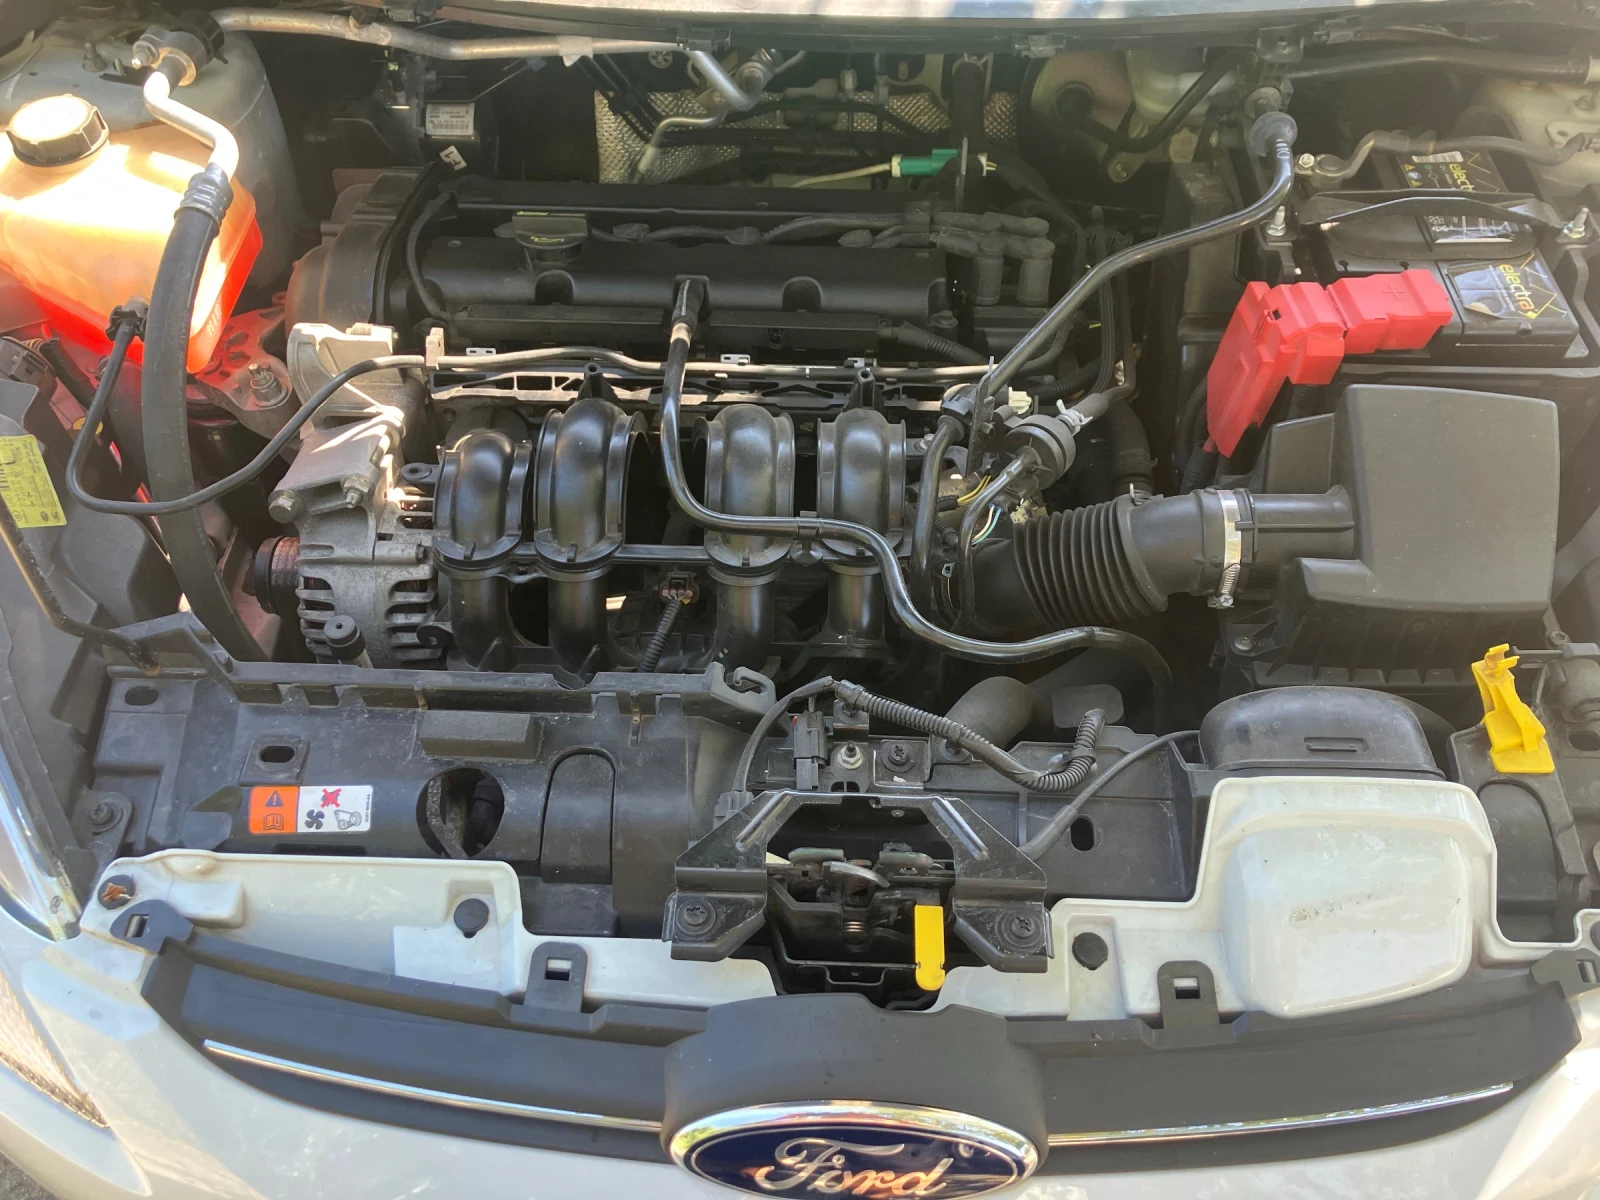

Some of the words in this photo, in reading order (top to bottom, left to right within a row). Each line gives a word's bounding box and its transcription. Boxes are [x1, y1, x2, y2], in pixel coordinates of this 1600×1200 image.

[1449, 163, 1474, 191] elect
[1500, 264, 1535, 310] electra
[753, 1137, 954, 1195] Ford
